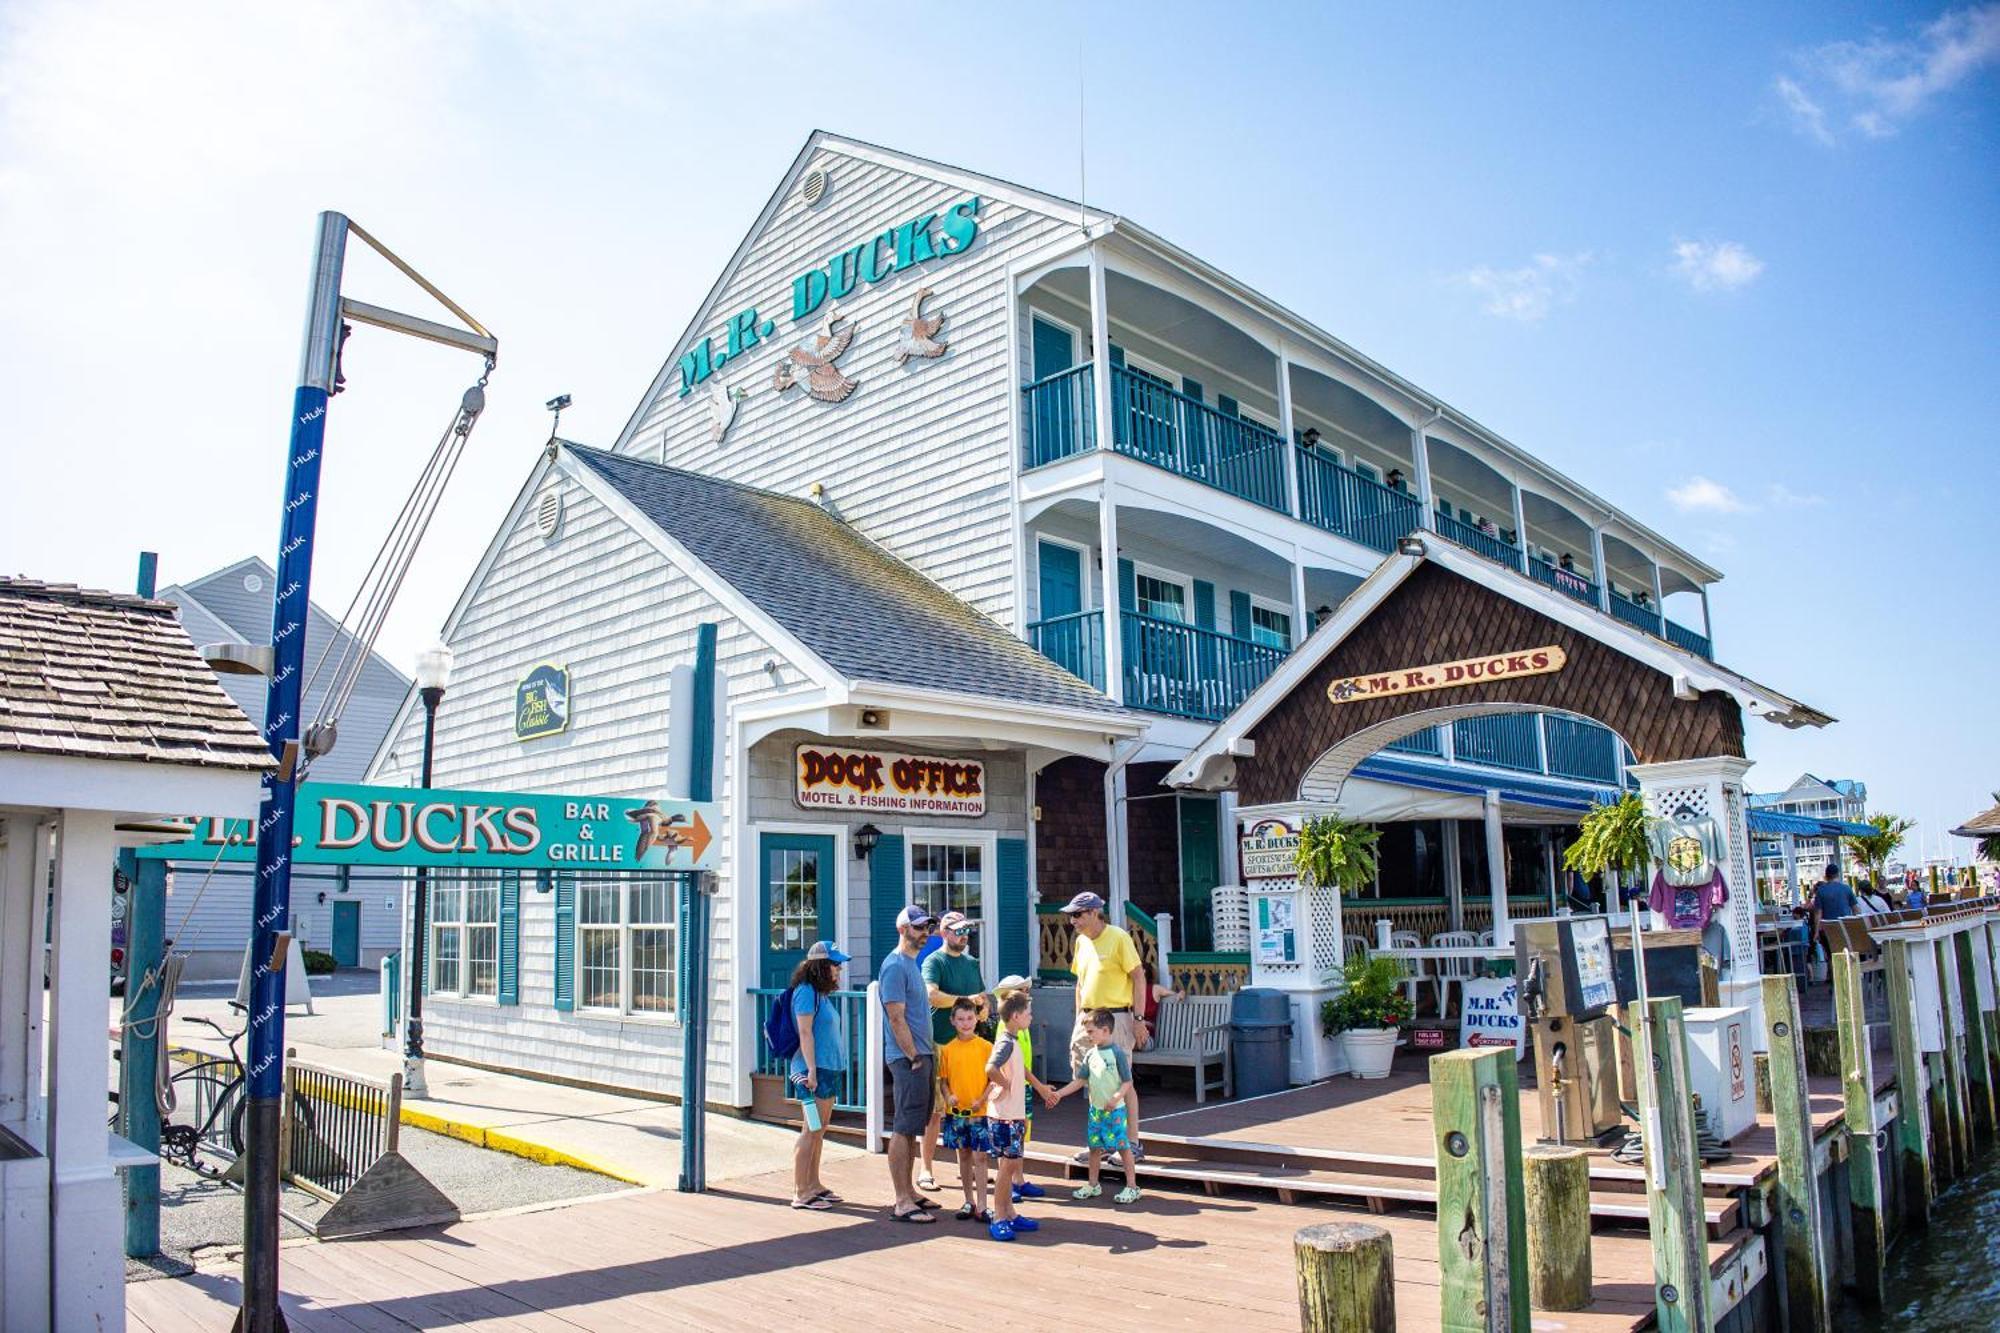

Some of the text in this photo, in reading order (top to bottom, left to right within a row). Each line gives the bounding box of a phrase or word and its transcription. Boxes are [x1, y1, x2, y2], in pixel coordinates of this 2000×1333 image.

[679, 196, 980, 399] M.R. DUCKS
[300, 405, 325, 425] Huk
[292, 448, 319, 468] Huk
[286, 491, 312, 512] Huk
[280, 535, 306, 559] Huk
[276, 580, 302, 605] Huk
[274, 621, 300, 643] Huk
[269, 664, 296, 689] Huk
[1444, 652, 1549, 682] DUCKS
[266, 711, 292, 736] Huk
[801, 750, 982, 798] DOCK OFFICE
[565, 802, 609, 821] BAR
[801, 791, 982, 813] MOTEL & FISHING INFORMATION
[260, 806, 285, 832] Huk
[317, 798, 541, 854] DUCKS
[579, 823, 595, 840] &
[1267, 836, 1299, 850] DUCKS
[548, 843, 623, 862] GRILLE
[261, 854, 288, 879] Huk
[258, 903, 285, 928] Huk
[252, 1002, 279, 1028] Huk
[1467, 997, 1500, 1010] M.R.
[1466, 1014, 1519, 1028] DUCKS
[251, 1052, 277, 1078] Huk
